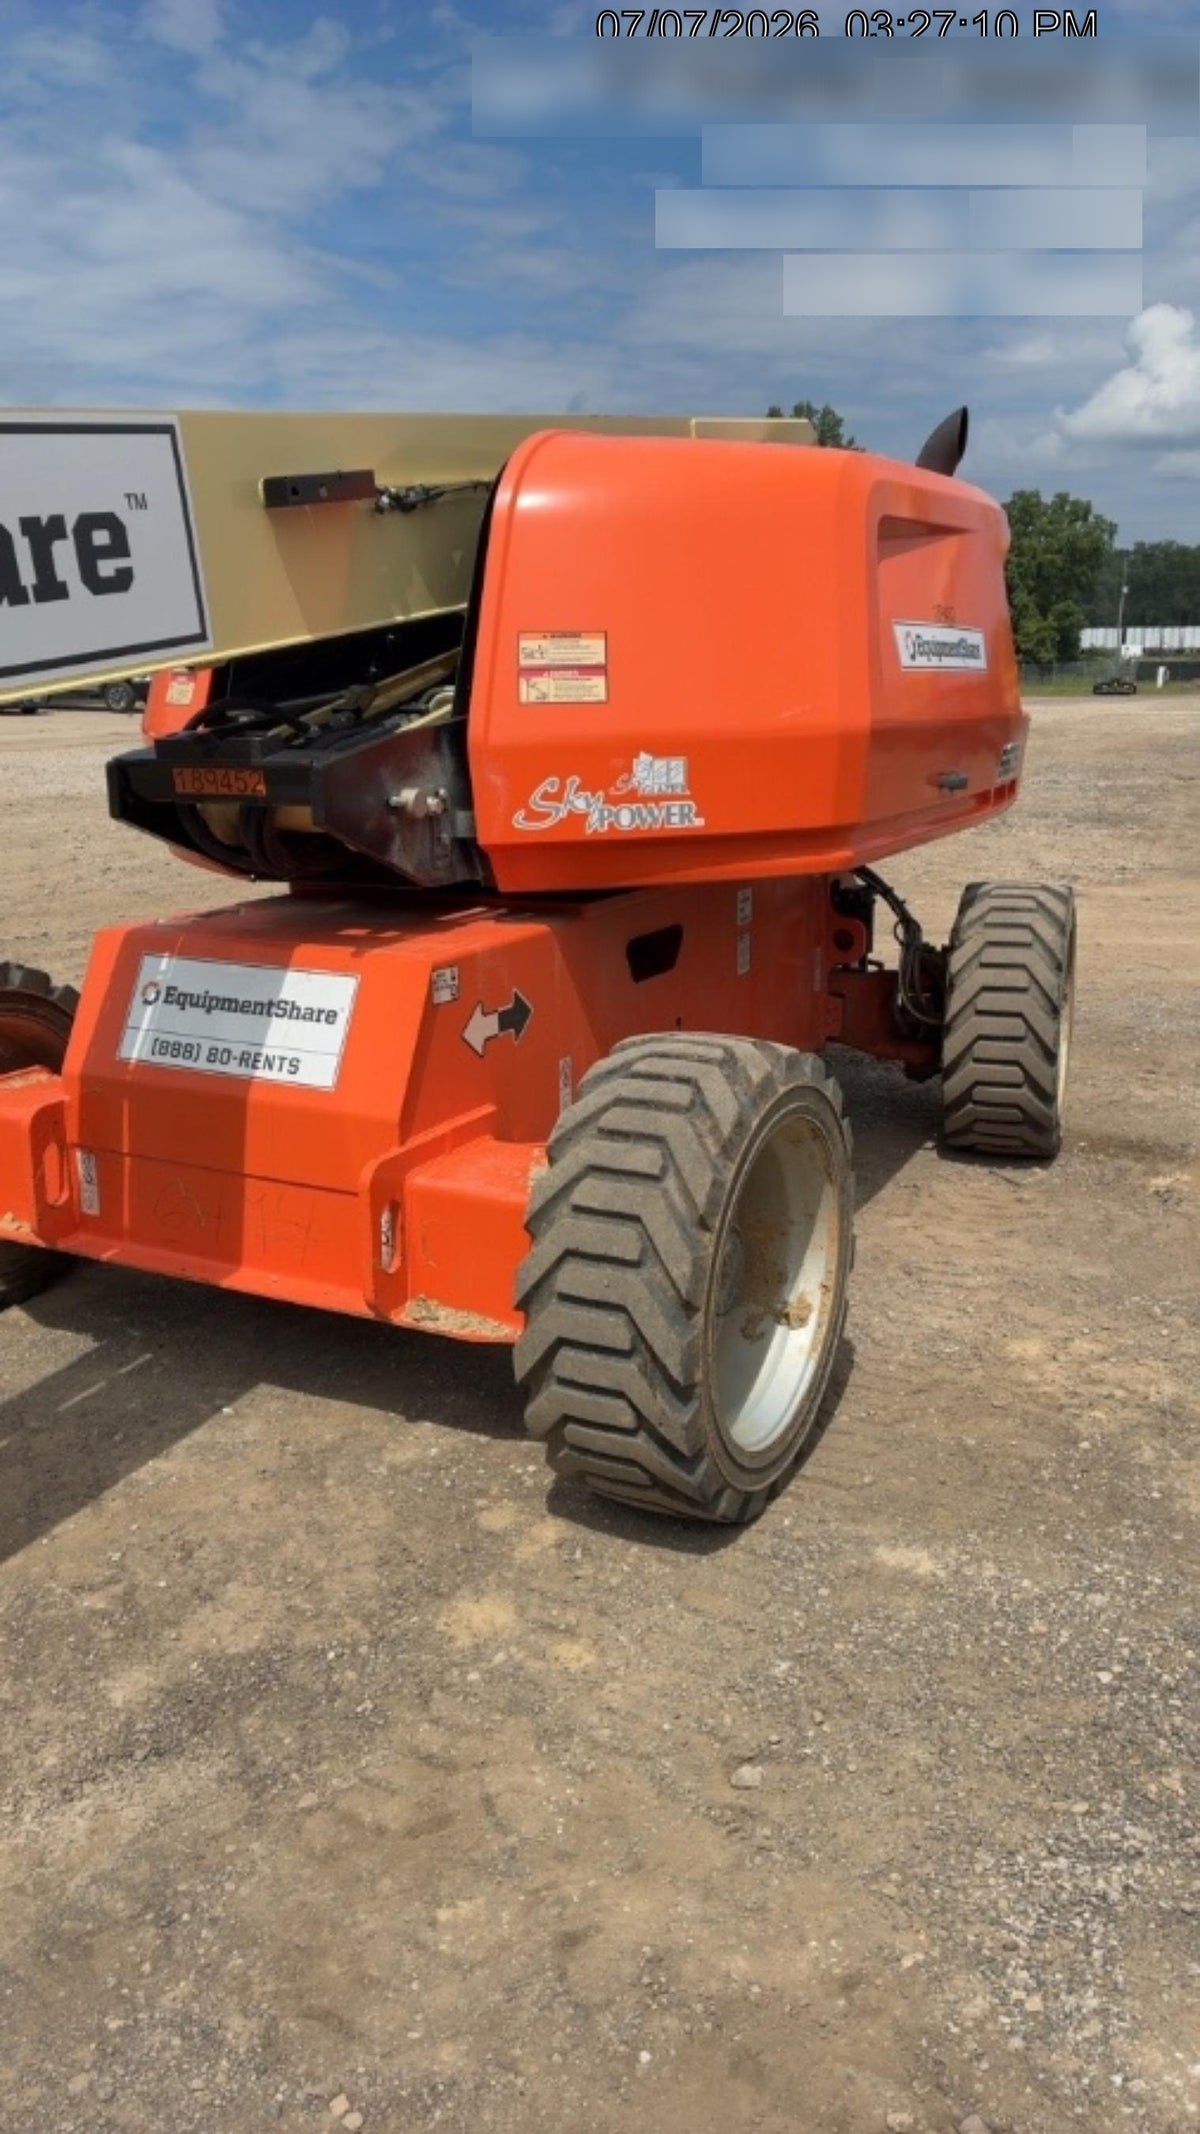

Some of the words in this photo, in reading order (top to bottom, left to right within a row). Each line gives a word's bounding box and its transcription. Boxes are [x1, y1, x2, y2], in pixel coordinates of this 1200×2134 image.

[176, 769, 263, 794] 189452
[597, 801, 696, 831] POWER
[163, 986, 338, 1025] EquipmentShare
[151, 1038, 202, 1062] (888)
[206, 1046, 301, 1075] 80-RENTS
